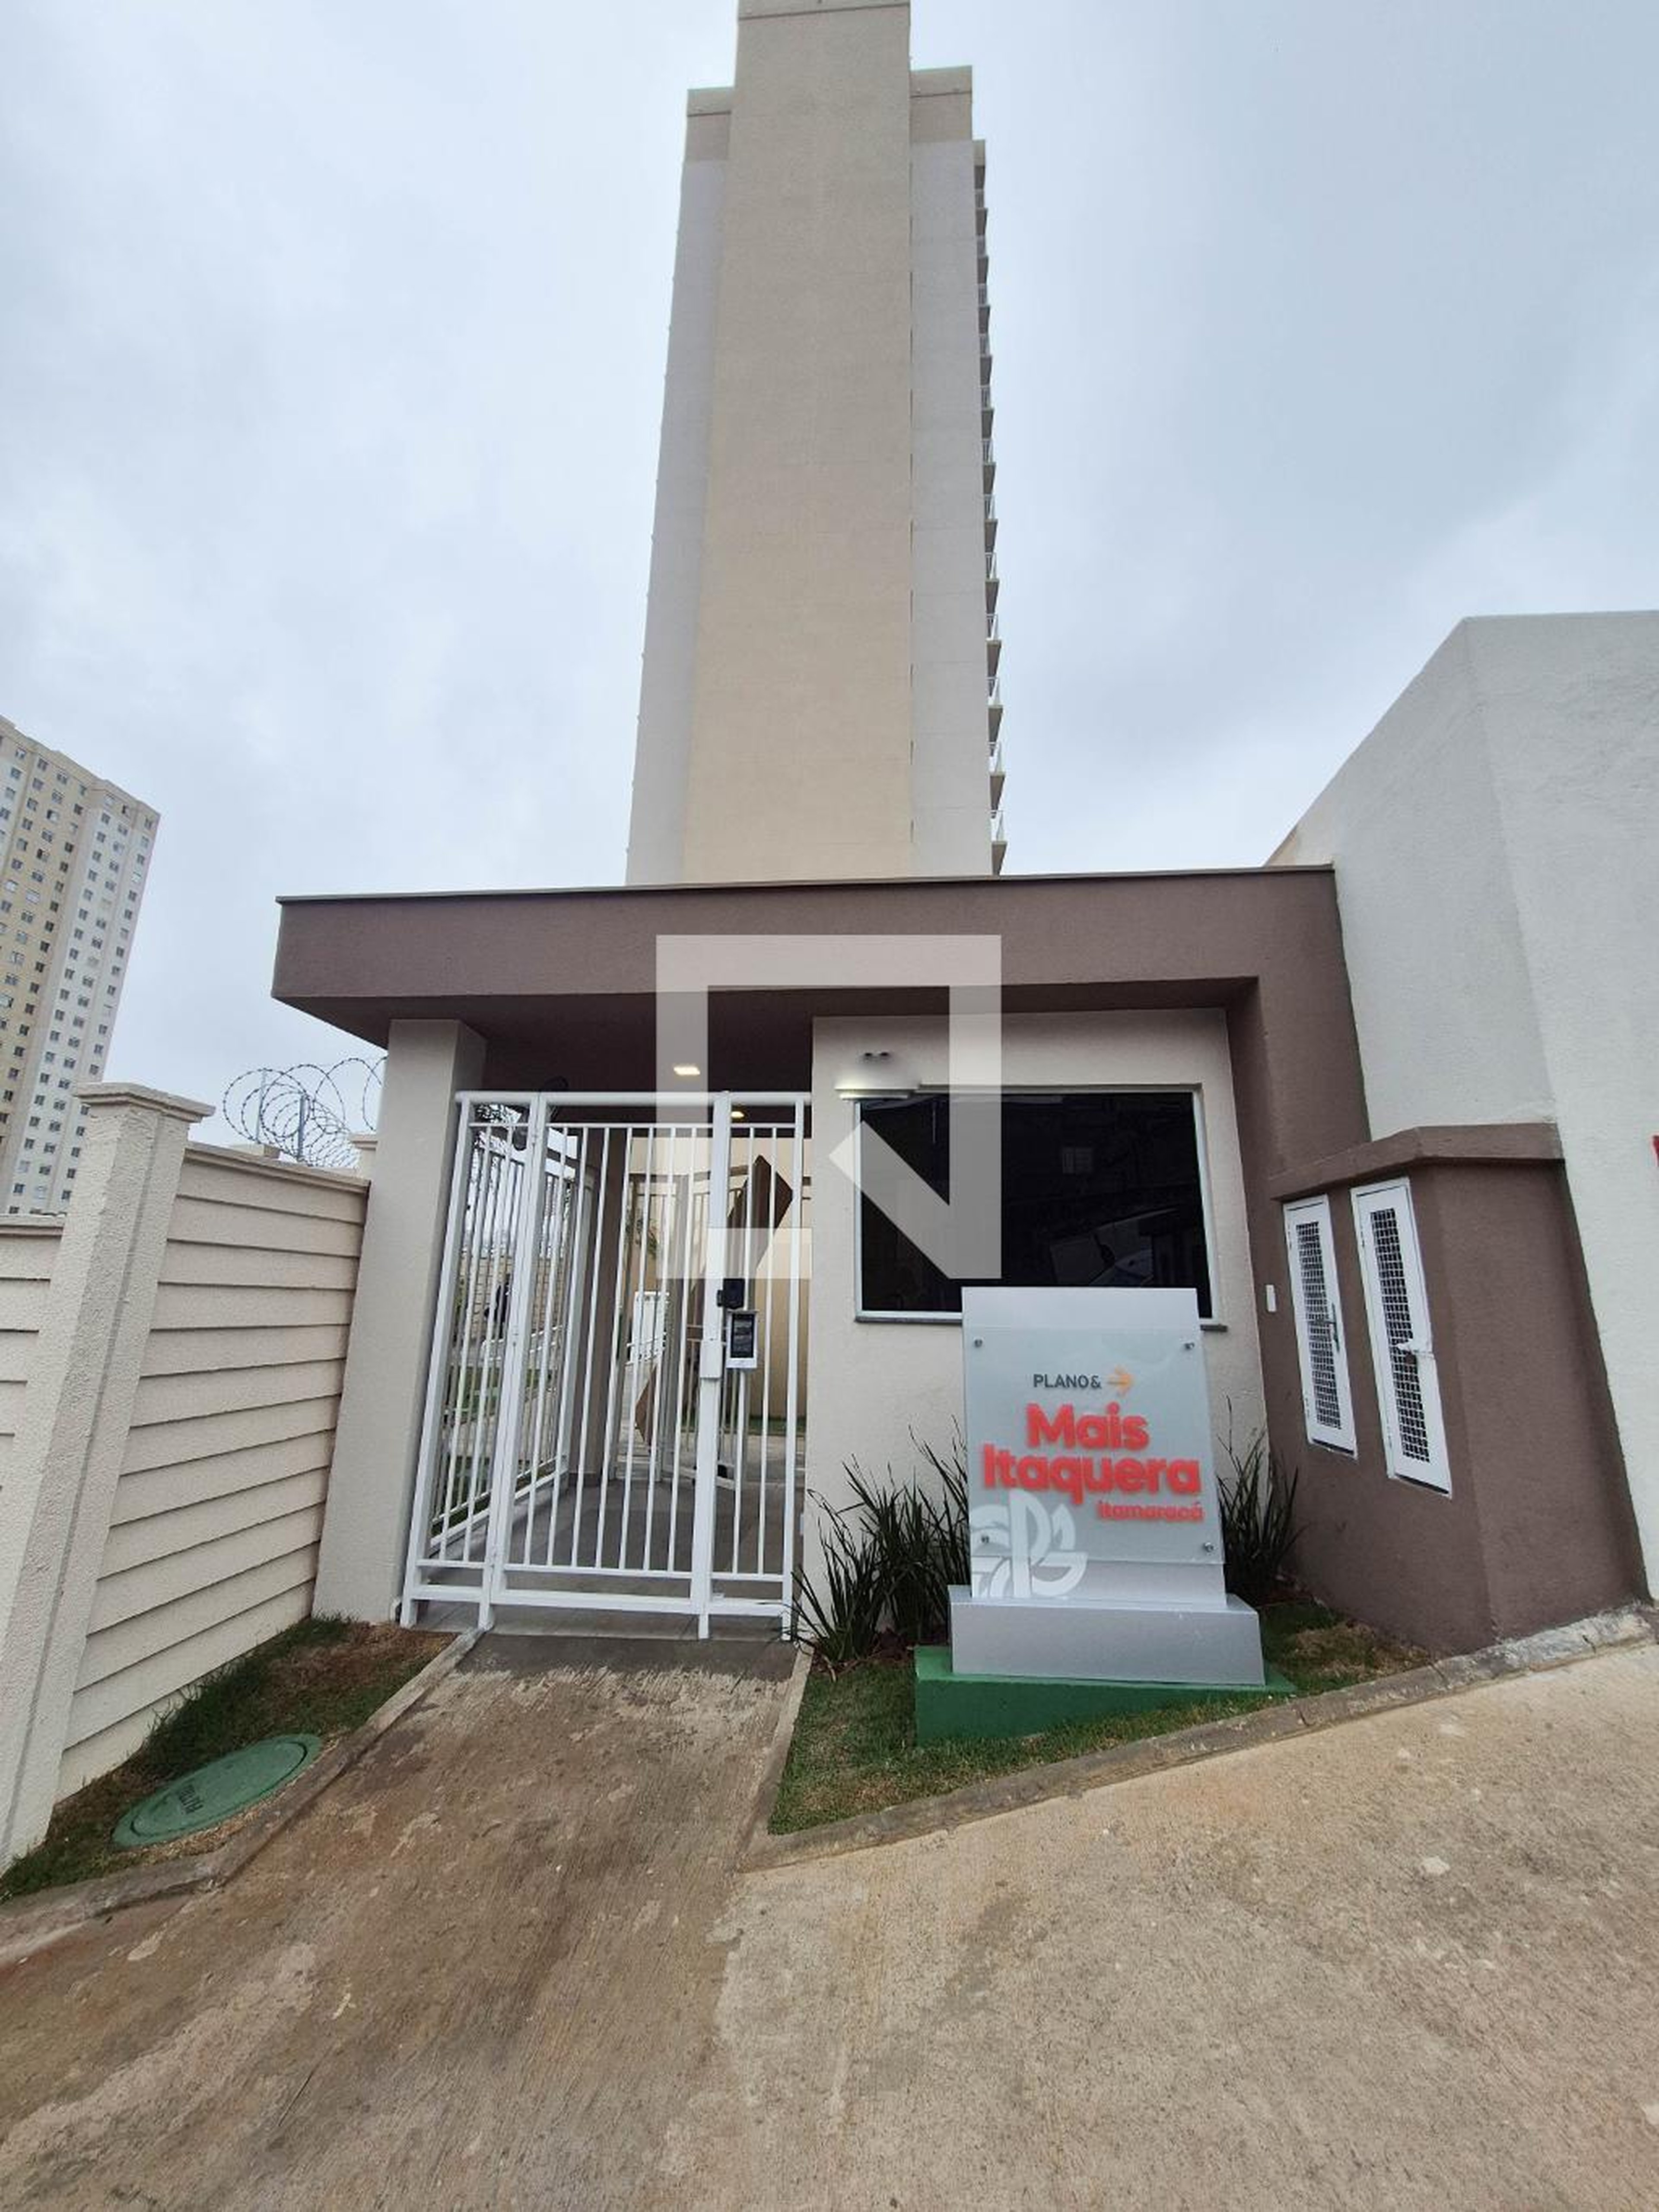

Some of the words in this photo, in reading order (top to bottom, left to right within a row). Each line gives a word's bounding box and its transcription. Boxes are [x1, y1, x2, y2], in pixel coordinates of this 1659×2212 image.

[1033, 1374, 1102, 1389] PLANO&
[1027, 1402, 1150, 1451] Mais
[983, 1443, 1202, 1505] Itaquera
